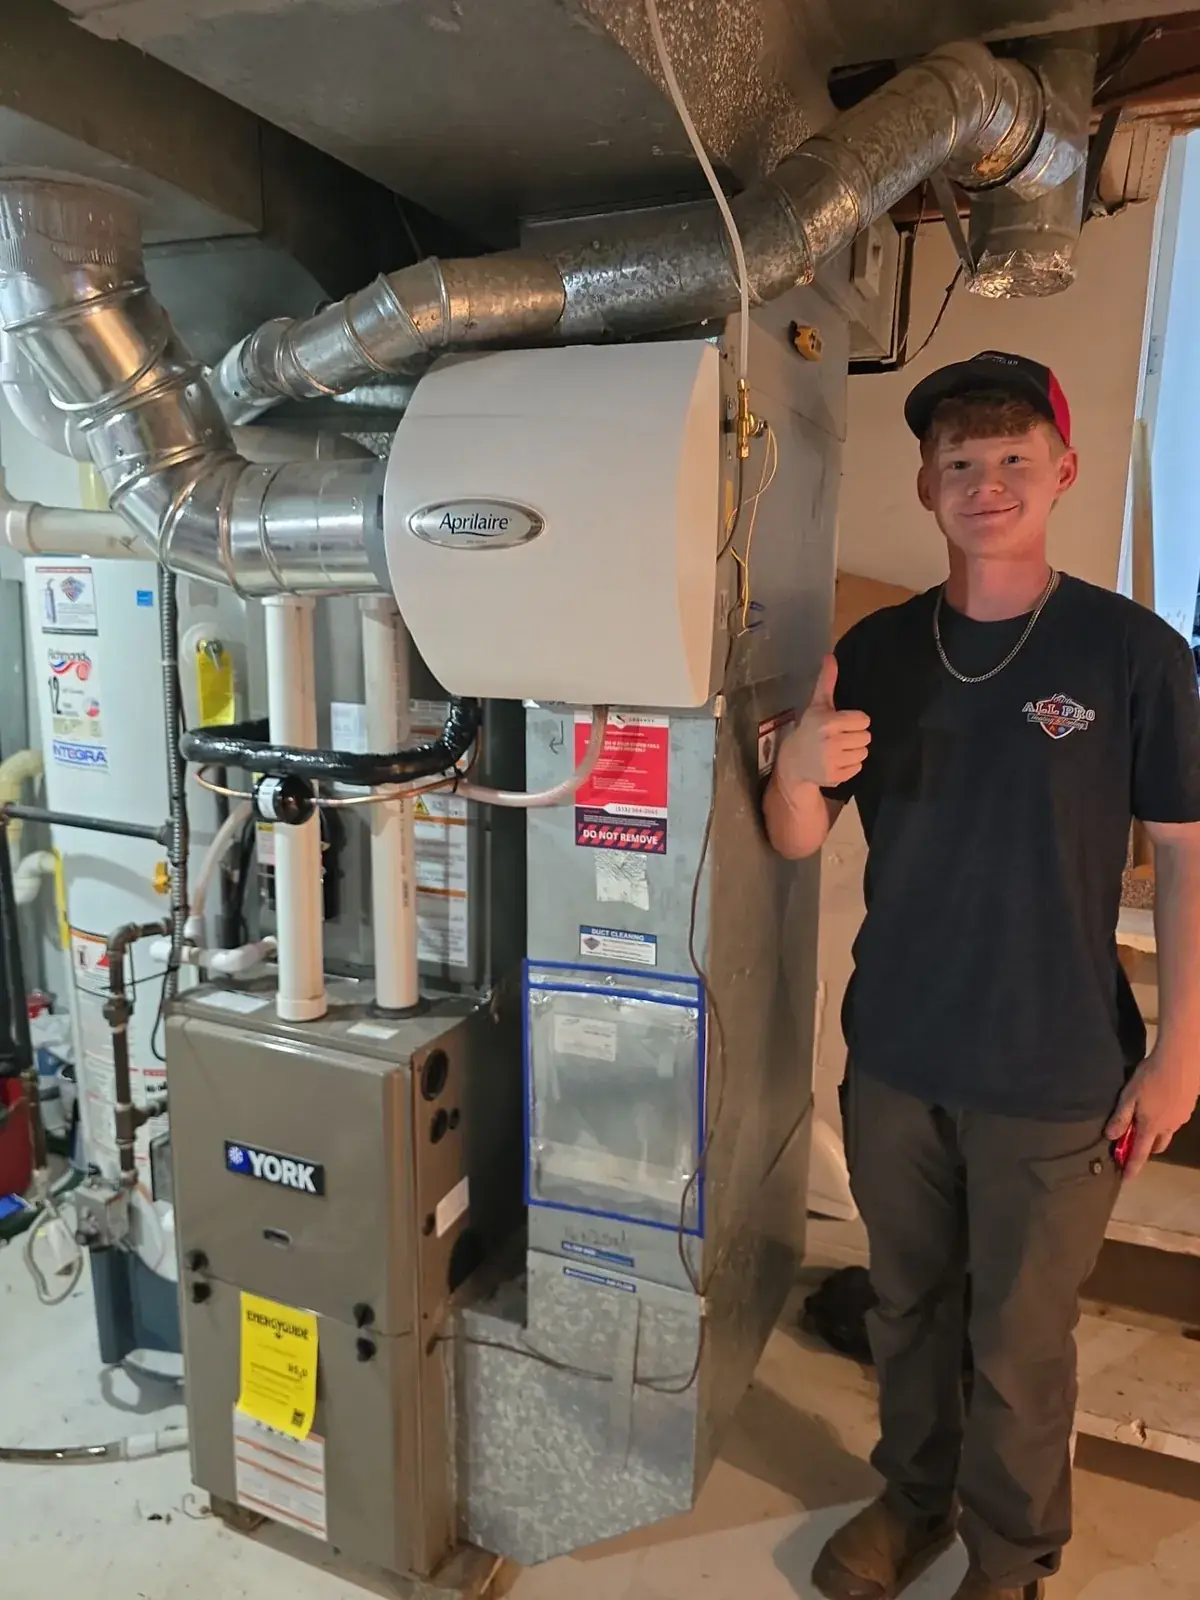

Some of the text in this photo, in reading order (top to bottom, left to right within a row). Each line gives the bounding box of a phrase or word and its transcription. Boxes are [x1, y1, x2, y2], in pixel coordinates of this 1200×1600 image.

[439, 512, 509, 535] Aprilaire
[1022, 702, 1096, 721] ALL PRO
[583, 829, 658, 845] DO NOT REMOVE
[591, 928, 645, 941] DUCT CLEANING
[248, 1149, 317, 1193] YORK
